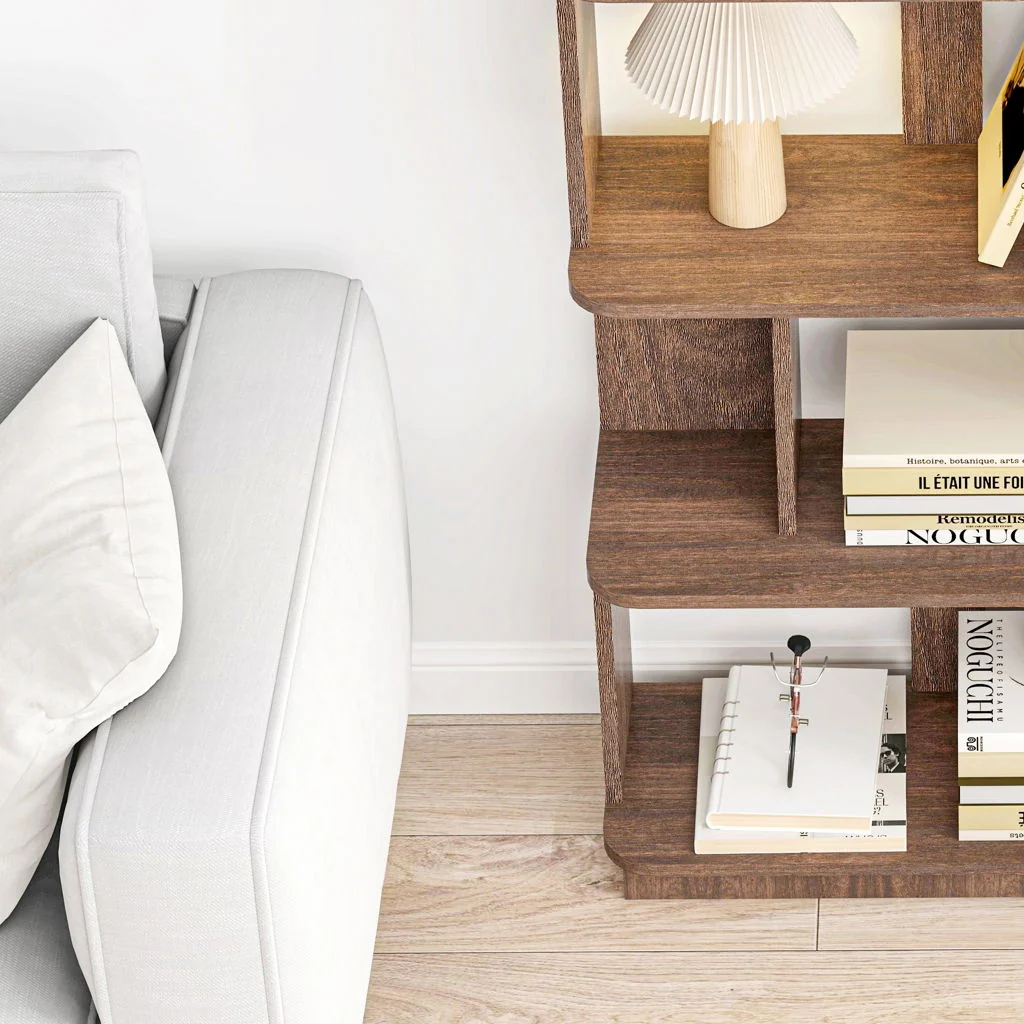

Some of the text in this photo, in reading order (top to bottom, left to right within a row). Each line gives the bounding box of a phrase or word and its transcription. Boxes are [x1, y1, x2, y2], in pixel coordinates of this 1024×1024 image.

[906, 458, 947, 466] Histoire,
[950, 458, 997, 466] botanique,
[918, 476, 930, 490] IL
[934, 474, 970, 490] ÉTAIT
[974, 476, 1000, 489] UNE
[966, 618, 994, 724] NOGUCHI
